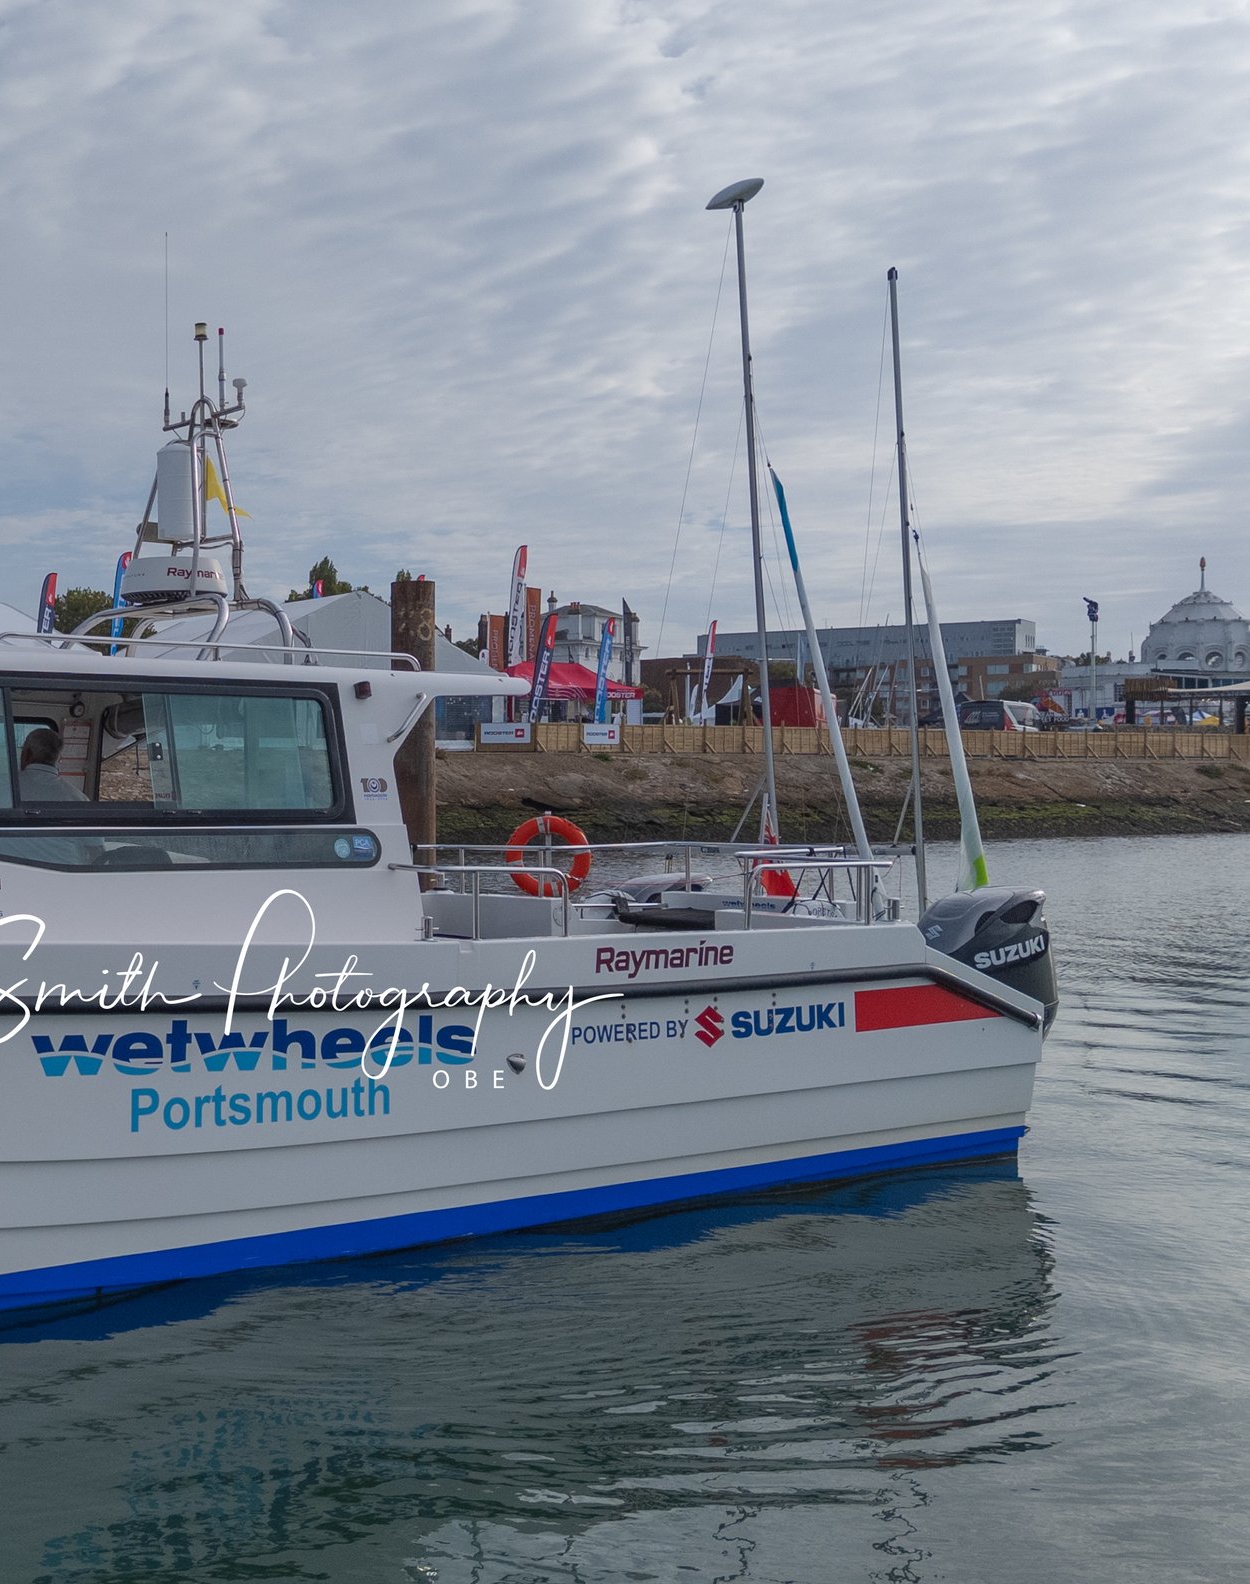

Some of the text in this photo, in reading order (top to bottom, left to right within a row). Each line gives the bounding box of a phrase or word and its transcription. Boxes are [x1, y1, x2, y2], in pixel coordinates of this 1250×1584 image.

[529, 651, 550, 724] OOSTER
[595, 940, 734, 979] Raymarine
[974, 934, 1045, 969] SUZUKI
[31, 1015, 477, 1077] wetwheels
[572, 1002, 846, 1045] POWERED BY SUZUKI
[130, 1076, 391, 1133] Portsmouth
